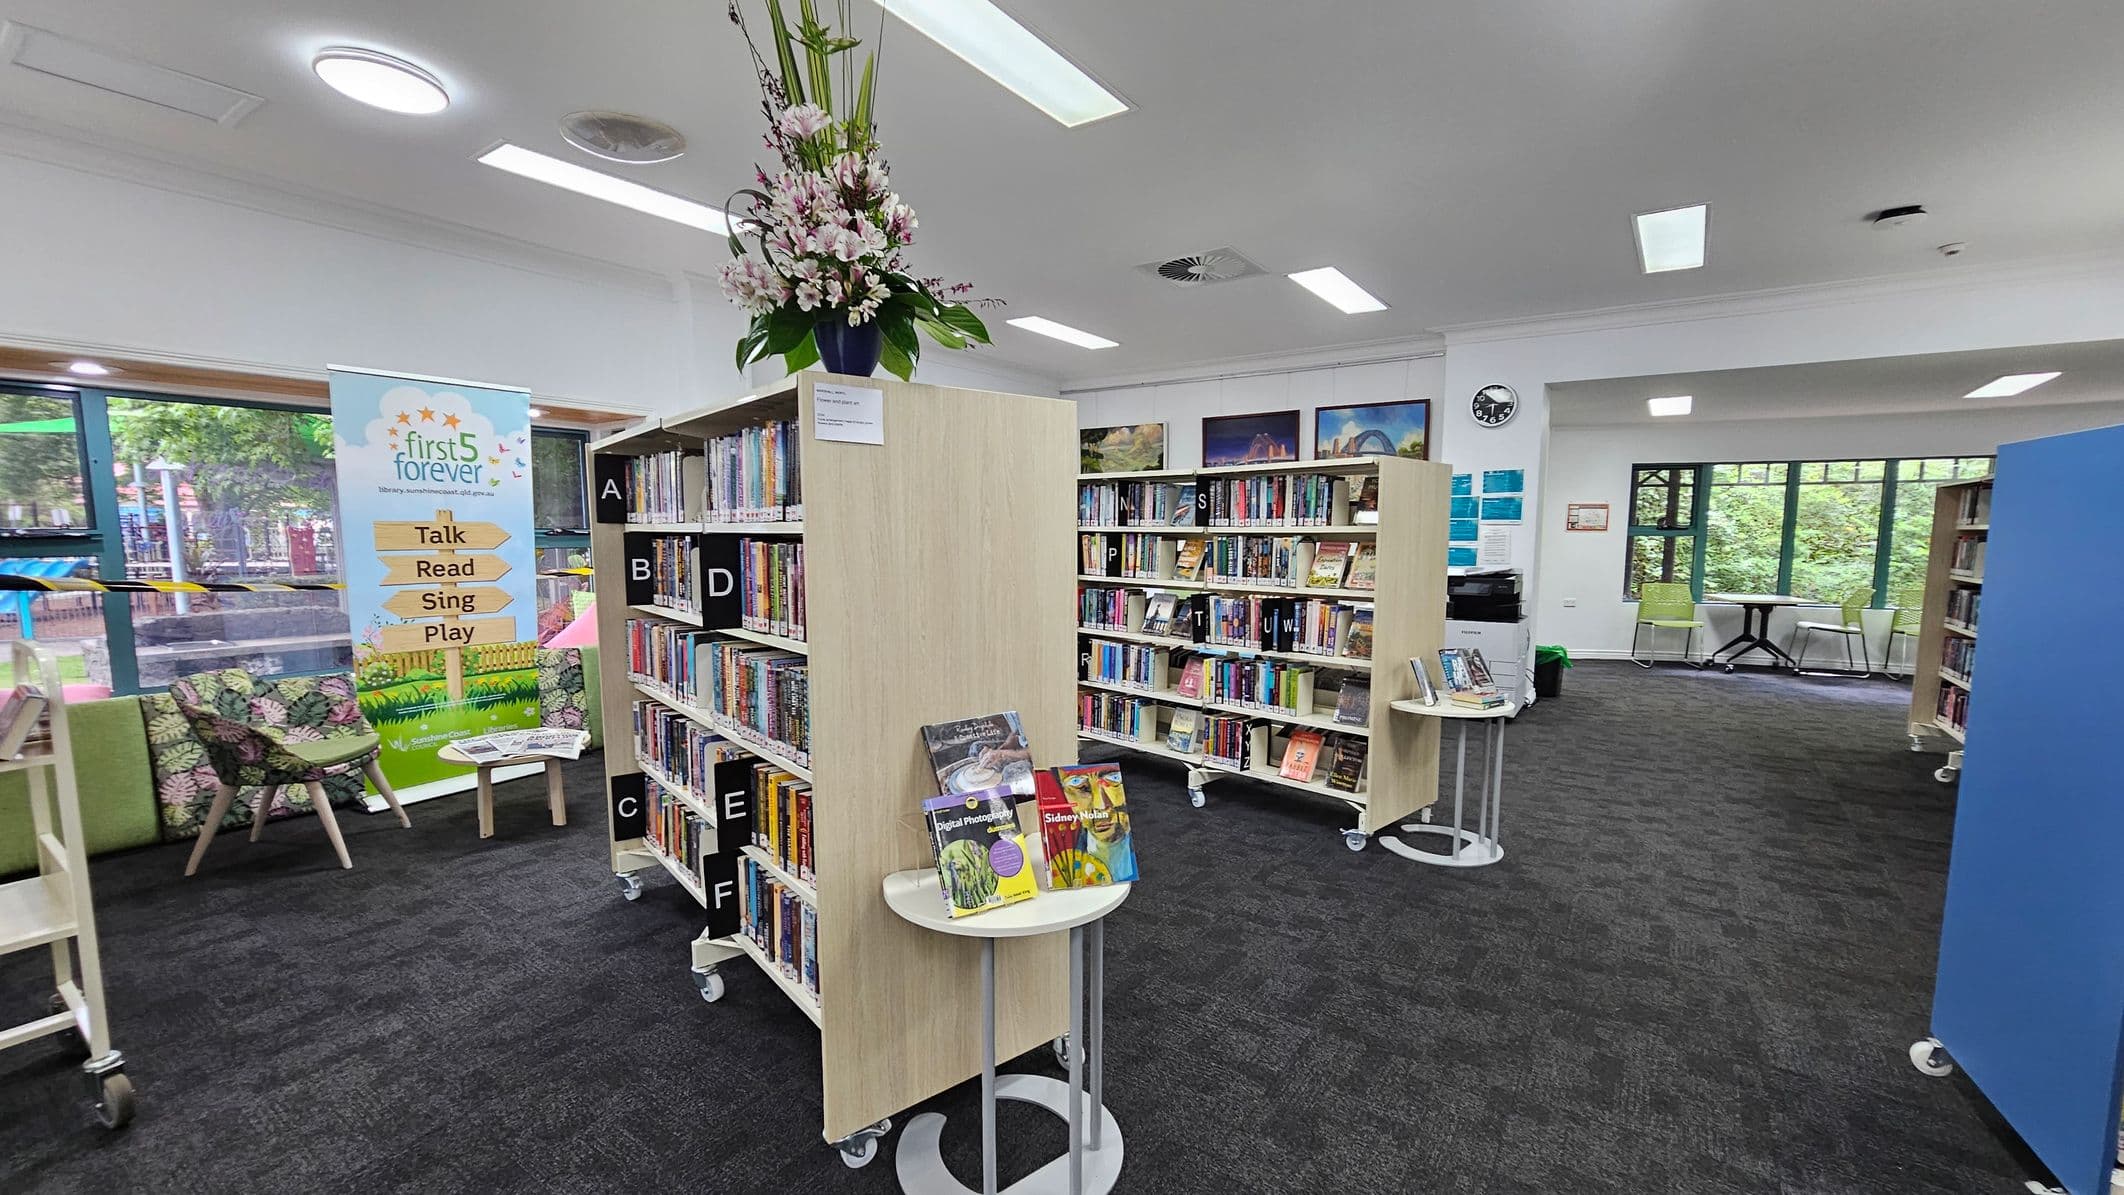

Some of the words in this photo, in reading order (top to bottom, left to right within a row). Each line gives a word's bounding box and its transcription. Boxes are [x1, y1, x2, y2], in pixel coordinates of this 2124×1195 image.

[1474, 402, 1480, 410] 9
[405, 431, 458, 461] first
[460, 432, 479, 463] 5
[394, 452, 483, 484] forever
[601, 479, 622, 500] A
[1198, 493, 1207, 510] S
[415, 525, 467, 544] Talk
[1108, 547, 1118, 562] P
[416, 558, 475, 578] Read
[631, 558, 651, 581] B
[708, 568, 734, 597] D
[422, 591, 476, 613] Sing
[1194, 611, 1204, 627] T
[1264, 616, 1273, 633] U
[1283, 619, 1294, 633] W
[425, 623, 475, 644] Play
[1081, 652, 1090, 667] R
[1246, 723, 1253, 735] X
[1245, 741, 1250, 752] Y
[1244, 756, 1250, 769] Z
[618, 796, 638, 818] C
[725, 790, 746, 820] E
[936, 818, 963, 832] Digital
[964, 808, 1014, 826] Photography
[1045, 812, 1078, 824] Sidney
[1080, 809, 1109, 820] Nolan
[715, 880, 733, 909] F
